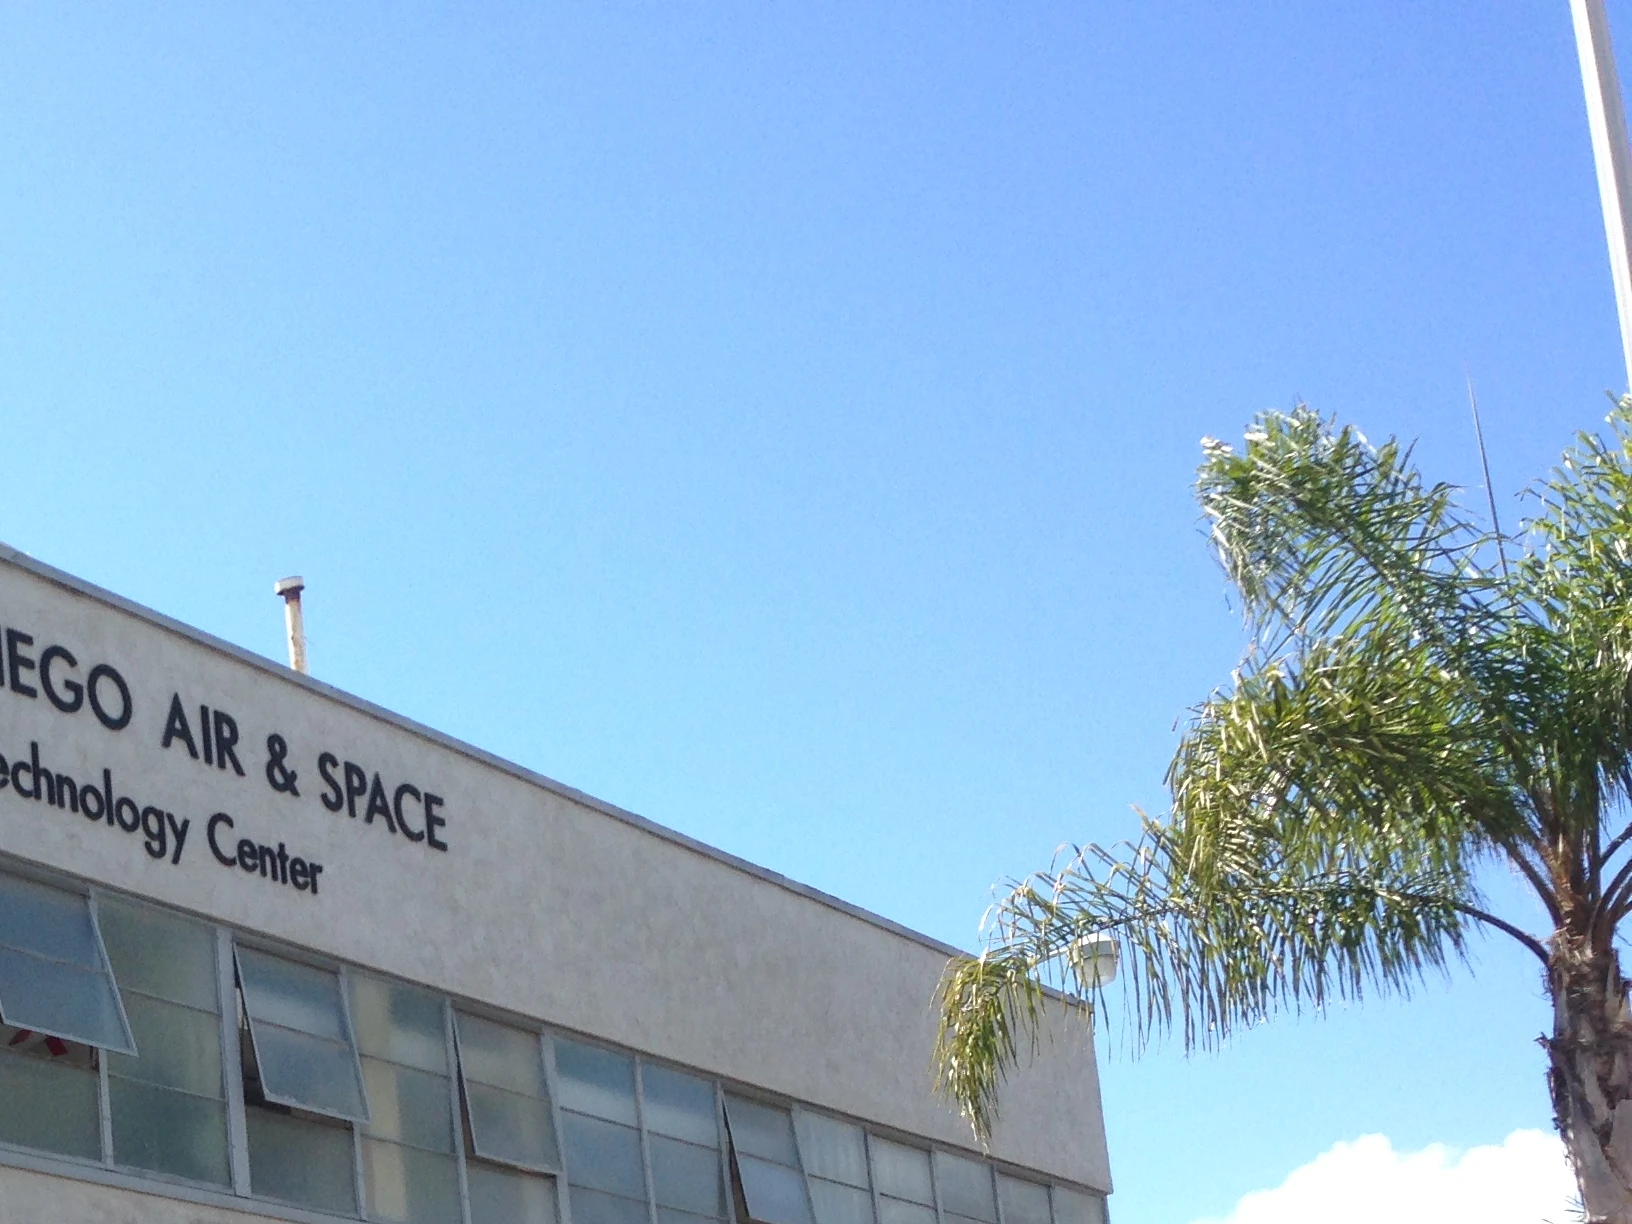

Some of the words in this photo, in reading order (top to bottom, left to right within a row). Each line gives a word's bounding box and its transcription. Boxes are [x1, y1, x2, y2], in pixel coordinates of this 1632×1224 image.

[162, 692, 245, 777] AIR
[266, 734, 299, 797] &
[319, 752, 448, 852] SPACE
[206, 813, 323, 895] Center
